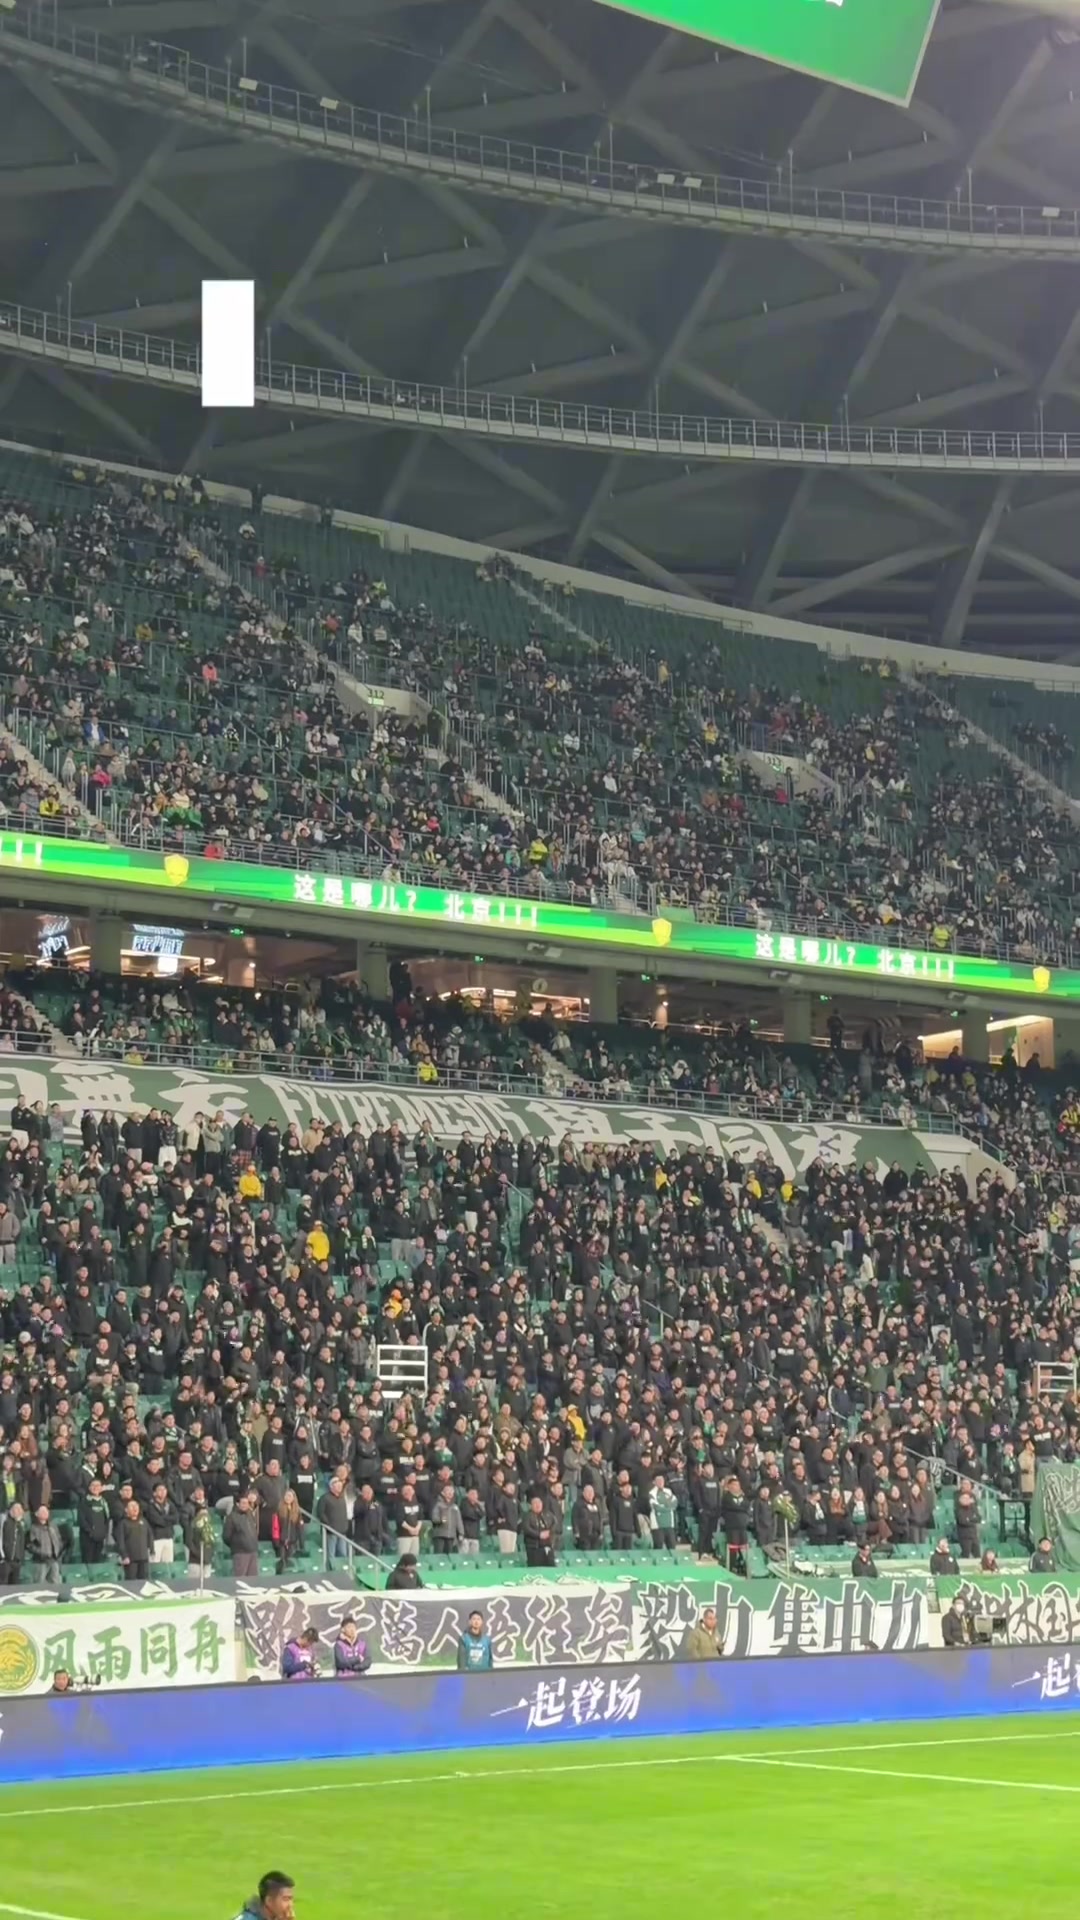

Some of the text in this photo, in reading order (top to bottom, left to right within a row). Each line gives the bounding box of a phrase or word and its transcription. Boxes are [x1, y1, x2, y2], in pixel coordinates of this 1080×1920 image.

[367, 688, 385, 699] 312
[293, 873, 417, 913] 这是哪儿?
[756, 933, 856, 968] 这是哪儿?
[38, 1614, 226, 1682] 风雨同舟
[1011, 1652, 1080, 1701] 一起
[490, 1672, 643, 1731] 一起登场
